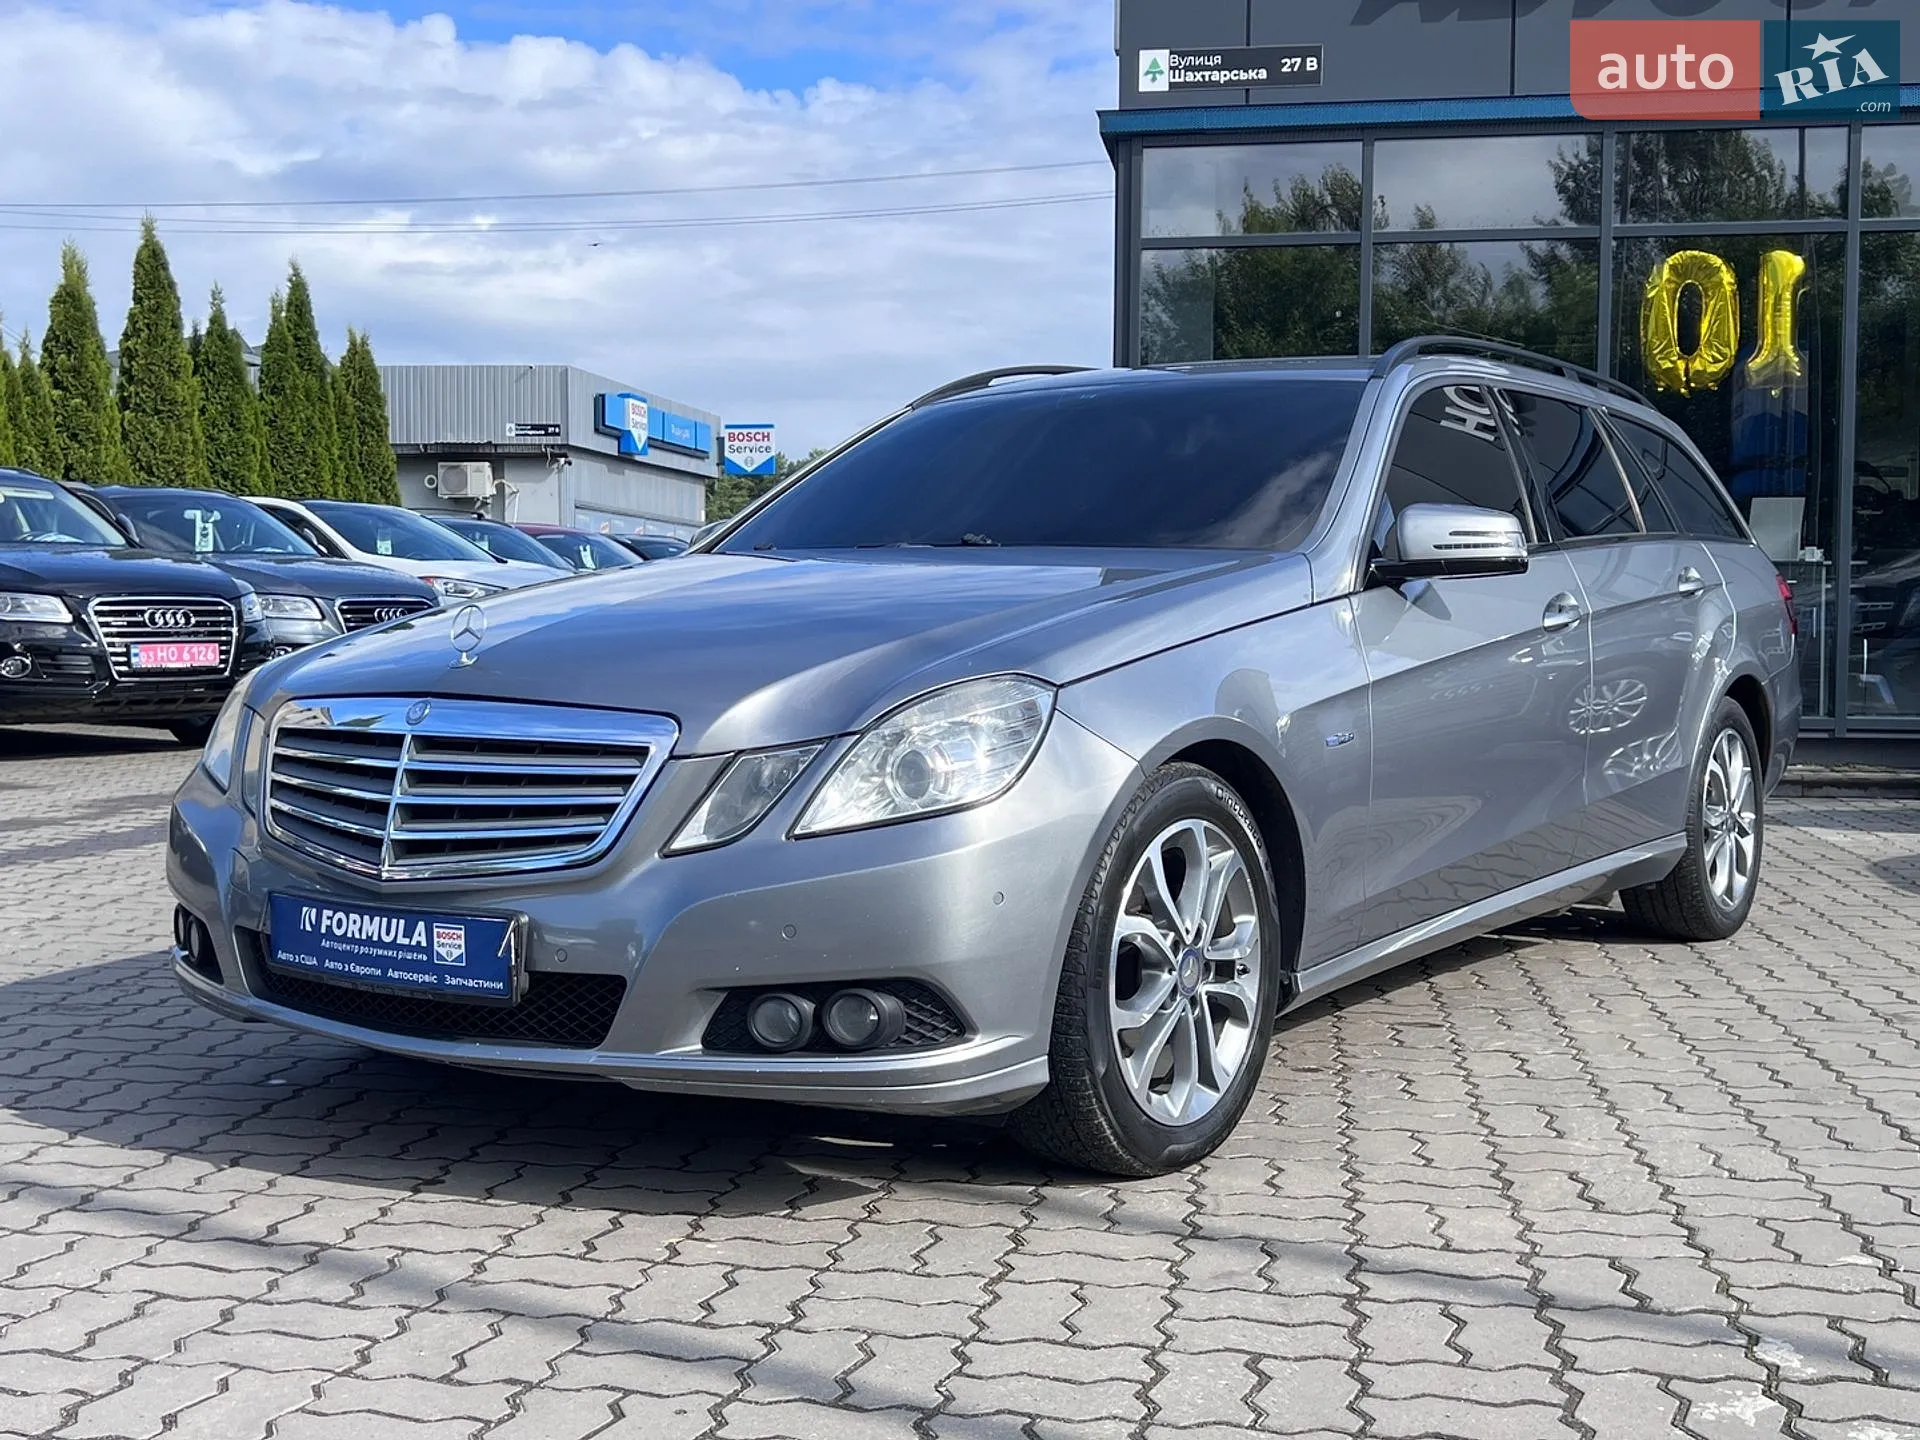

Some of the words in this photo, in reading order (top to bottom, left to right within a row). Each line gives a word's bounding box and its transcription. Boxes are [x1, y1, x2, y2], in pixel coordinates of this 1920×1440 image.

[1169, 54, 1222, 68] Вулиця
[1281, 58, 1301, 72] 27
[1169, 68, 1267, 83] Шахтарська
[727, 431, 770, 442] BOSCH
[728, 444, 772, 454] Service
[183, 646, 215, 660] 6126
[320, 909, 428, 947] FORMULA
[436, 930, 462, 941] BOSCH
[321, 938, 360, 954] Автоцентр
[360, 945, 397, 958] розумних
[397, 949, 428, 961] рішень
[436, 940, 462, 950] Service
[277, 950, 294, 961] Авто
[300, 954, 318, 966] США
[324, 959, 343, 971] Авто
[350, 963, 381, 976] Європи
[387, 968, 438, 983] Автосервіс
[444, 974, 504, 990] Запчастини
